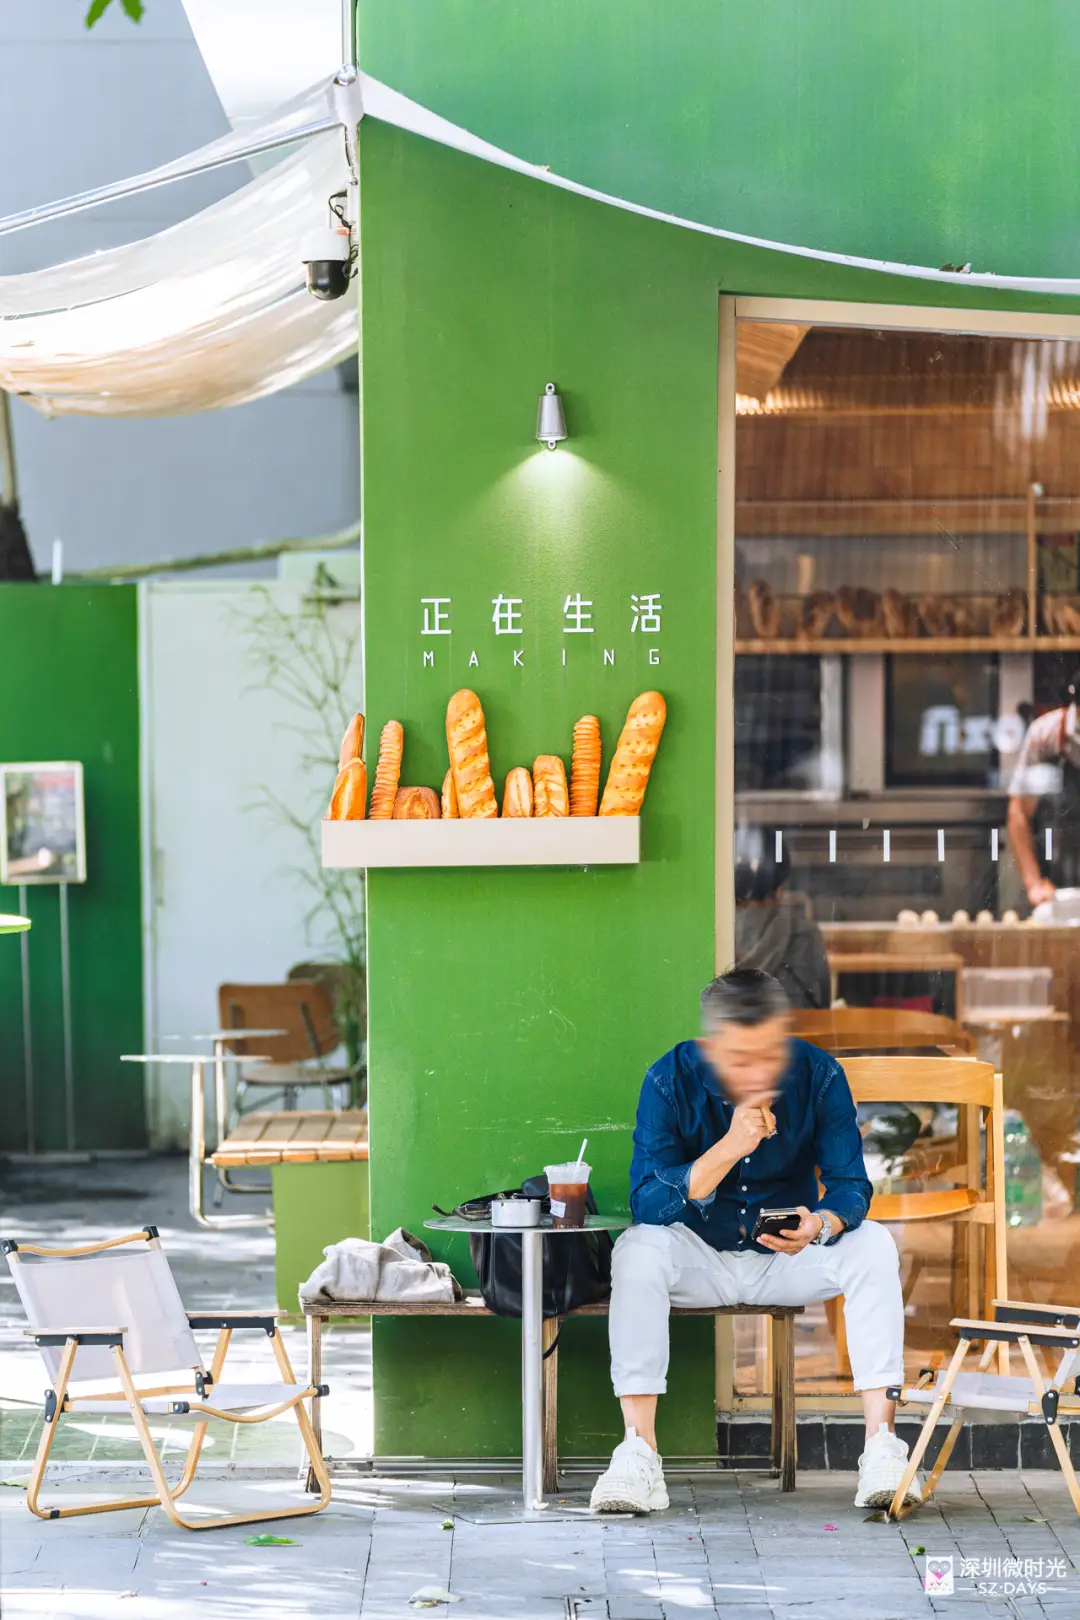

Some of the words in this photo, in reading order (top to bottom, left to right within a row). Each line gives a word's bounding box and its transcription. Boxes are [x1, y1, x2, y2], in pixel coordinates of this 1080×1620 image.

[421, 593, 662, 635] 正在生活
[423, 649, 660, 667] MAKING
